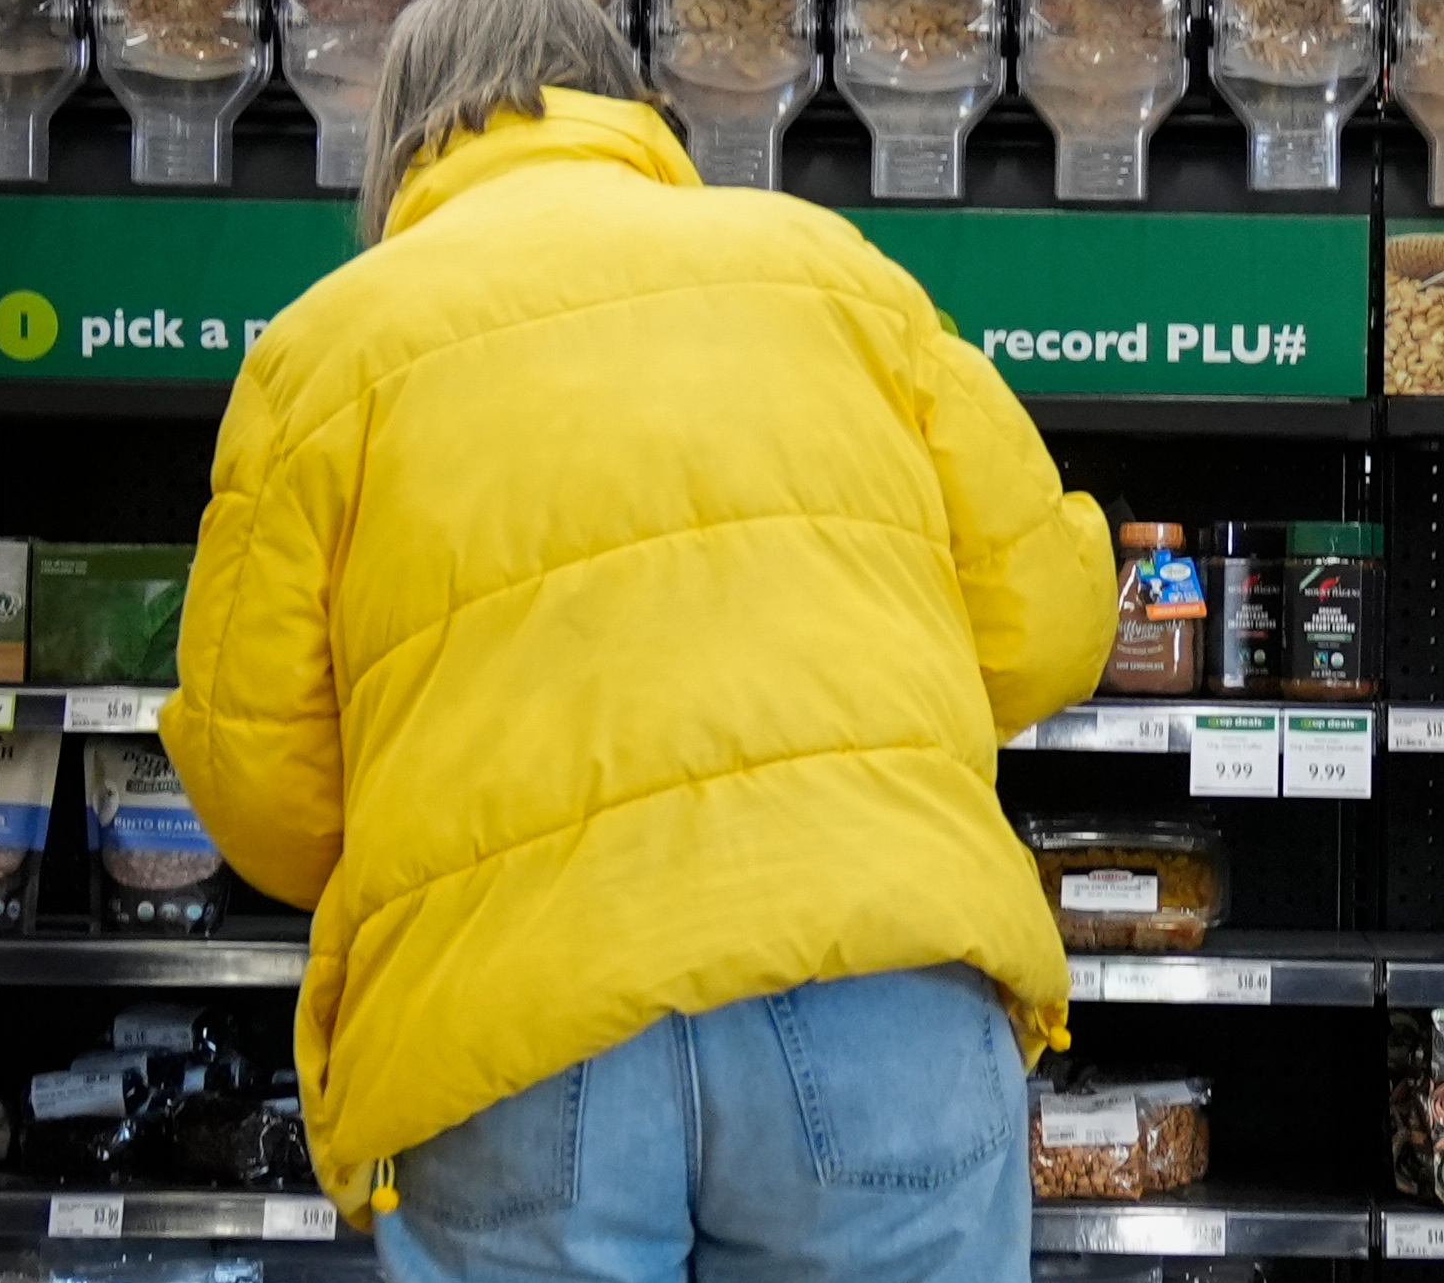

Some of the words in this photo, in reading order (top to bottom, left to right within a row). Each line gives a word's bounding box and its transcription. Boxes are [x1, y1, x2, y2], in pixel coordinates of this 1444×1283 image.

[82, 308, 184, 357] pick
[201, 319, 229, 349] a
[984, 323, 1148, 361] record
[1167, 323, 1306, 364] PLU#
[1216, 763, 1252, 779] 9.99
[1309, 763, 1345, 780] 9.99
